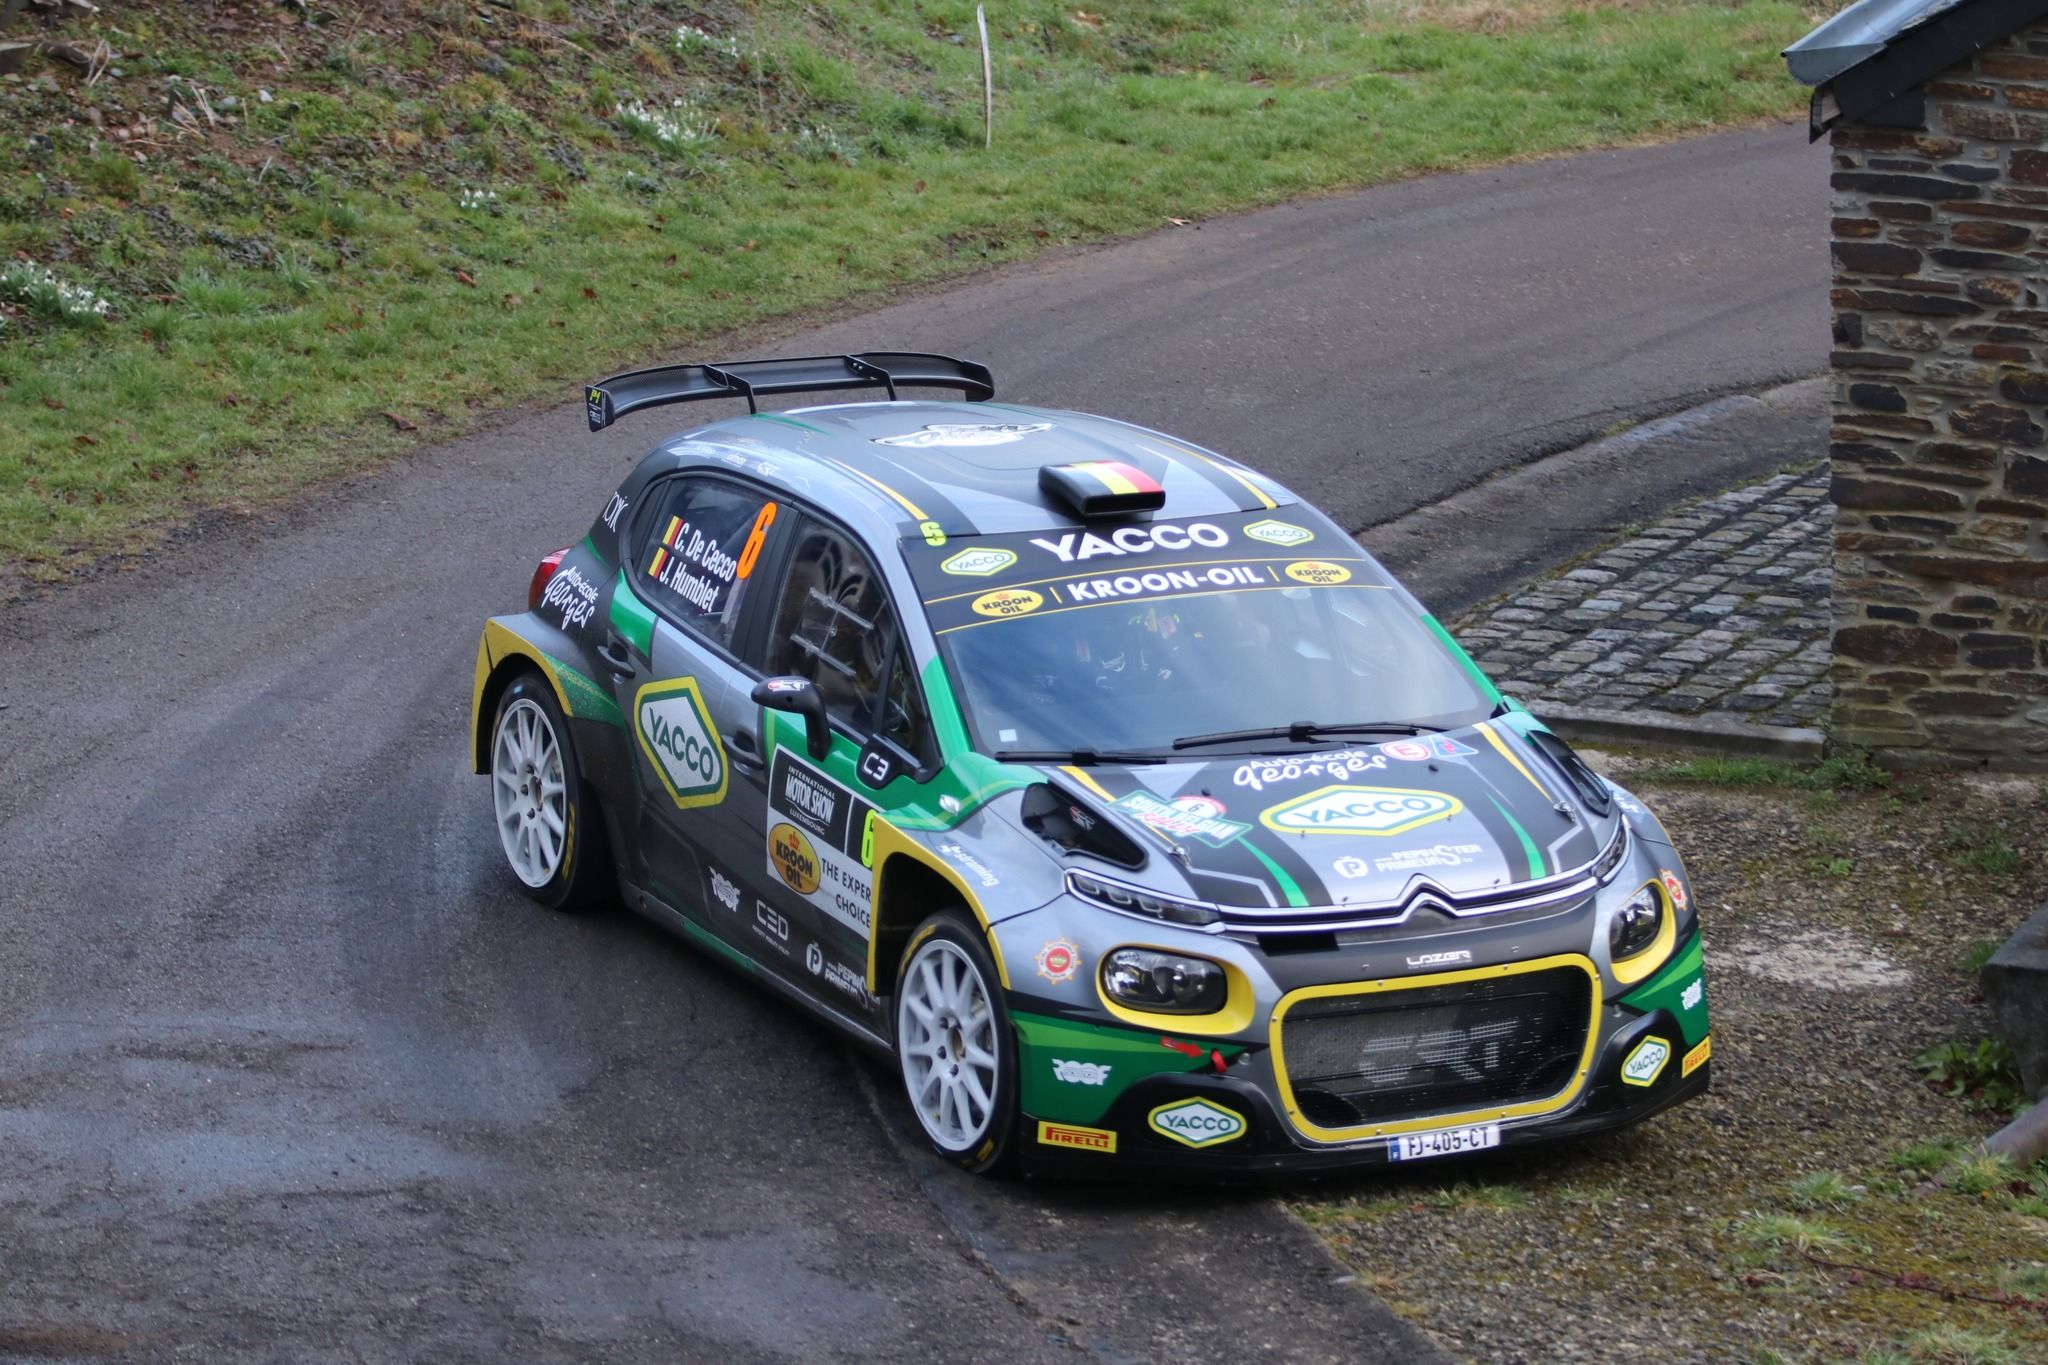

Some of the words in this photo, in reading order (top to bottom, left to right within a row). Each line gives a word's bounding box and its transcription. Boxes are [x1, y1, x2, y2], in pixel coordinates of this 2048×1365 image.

[674, 522, 690, 552] C.
[685, 529, 705, 562] De
[701, 539, 738, 582] Cecco
[737, 502, 777, 579] 6
[1029, 523, 1229, 563] YACCO
[953, 553, 1006, 570] YACCO
[1294, 569, 1342, 577] KROON
[659, 556, 675, 584] J.
[670, 561, 720, 613] Humblet
[1066, 566, 1265, 602] KROON-OIL
[981, 596, 1034, 611] KROON
[1000, 606, 1024, 614] OIL
[648, 706, 714, 782] YACCO
[863, 752, 889, 781] C3
[788, 765, 835, 800] INTERNATIONAL
[785, 773, 811, 811] MOTOR
[810, 789, 835, 824] SHOW
[1293, 796, 1433, 824] YACCO
[789, 808, 825, 835] LUXEMBOURG
[776, 839, 812, 878] KROON
[821, 858, 839, 882] THE
[786, 865, 802, 888] OIL
[835, 894, 871, 928] CHOICE
[1629, 1049, 1663, 1074] YACCO
[1045, 1126, 1110, 1149] PIRELLI
[1165, 1114, 1232, 1132] YACCO
[1407, 1126, 1489, 1157] FJ-405-CT
